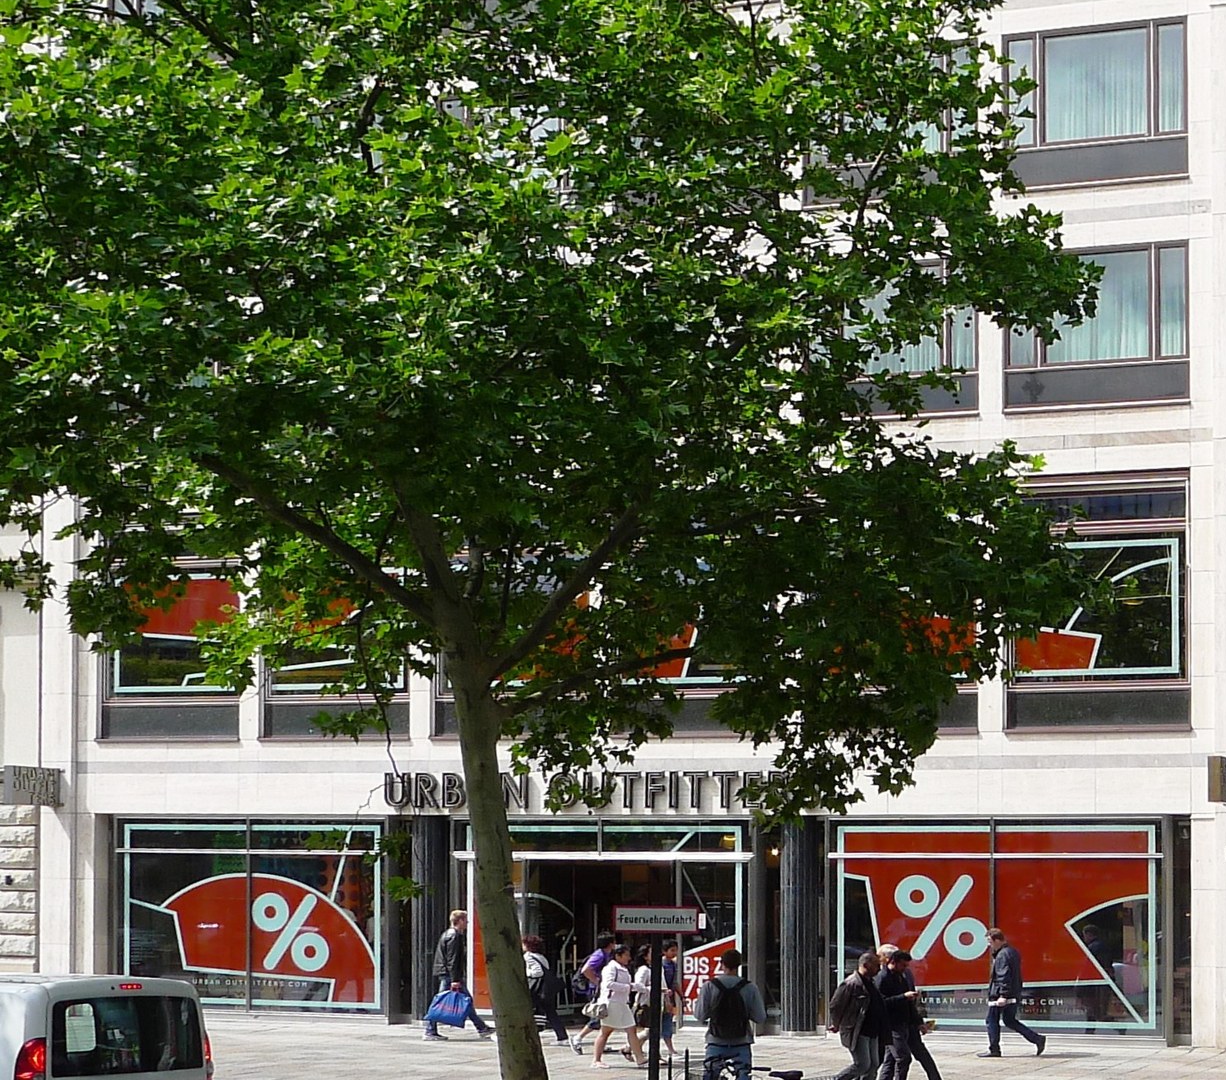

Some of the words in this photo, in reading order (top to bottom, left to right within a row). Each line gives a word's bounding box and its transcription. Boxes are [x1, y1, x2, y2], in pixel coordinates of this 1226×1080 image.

[384, 772, 529, 809] URBN
[620, 914, 692, 925] Feuerwehrzufahrt
[683, 956, 710, 974] BIS
